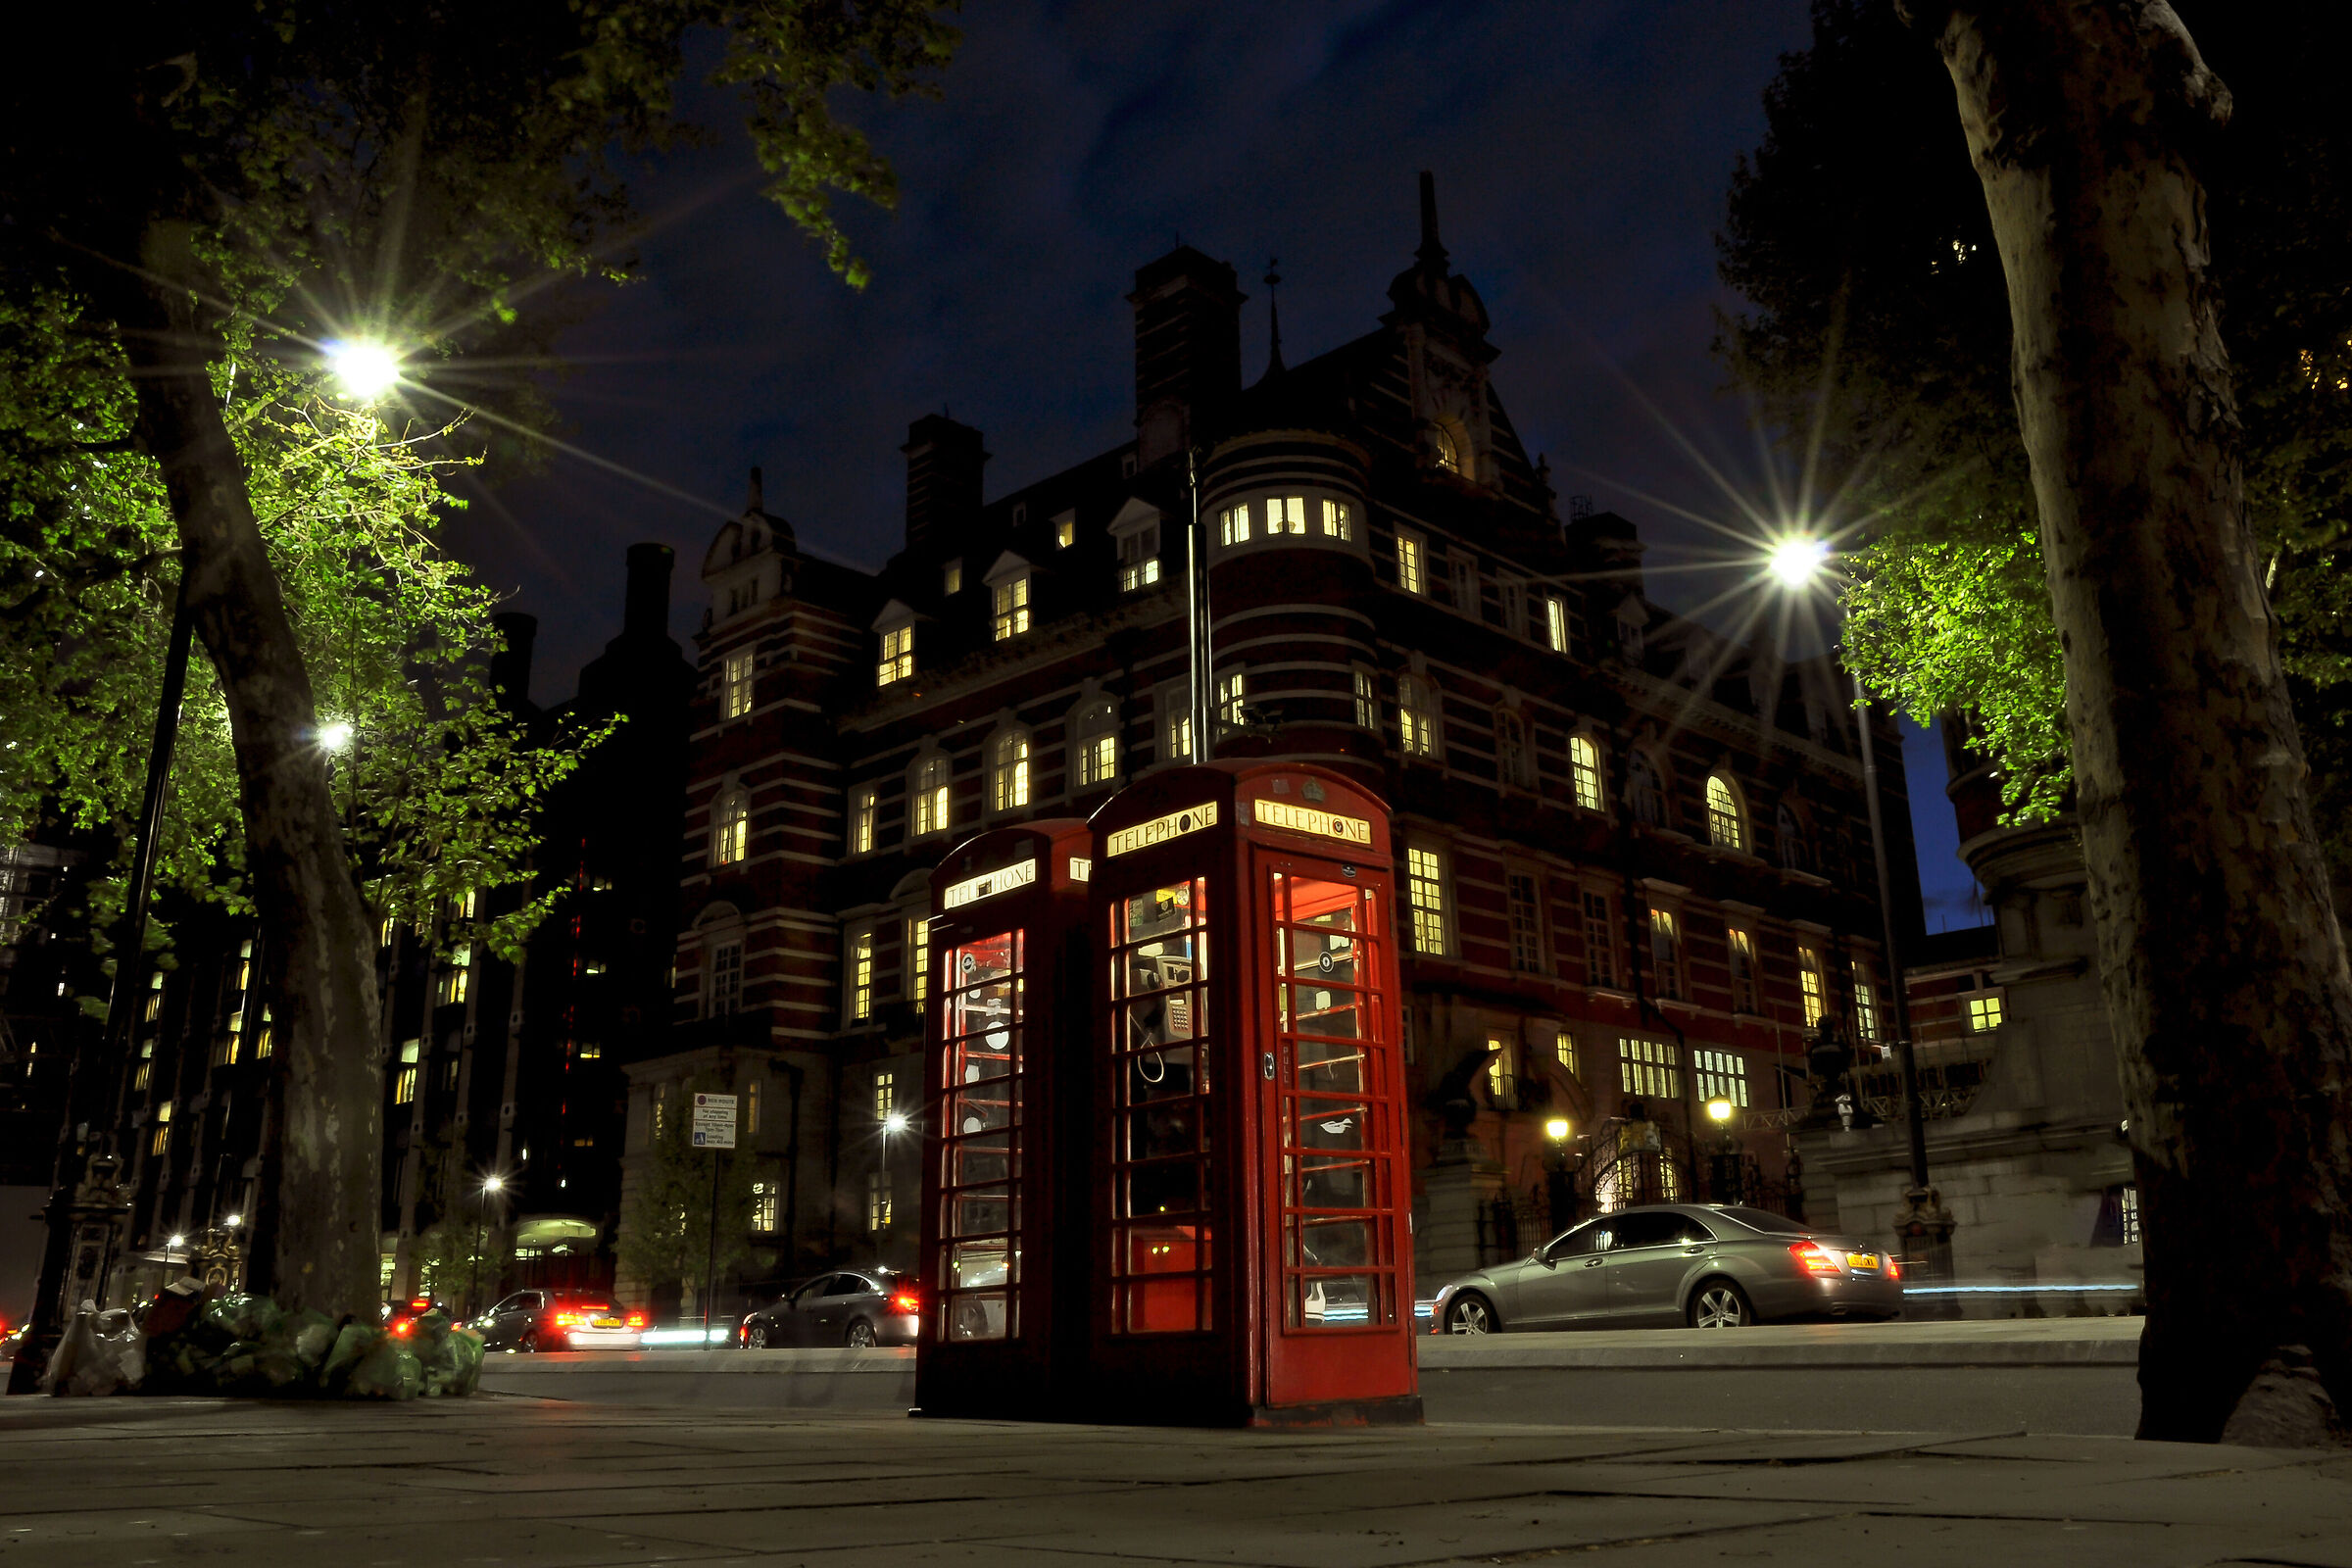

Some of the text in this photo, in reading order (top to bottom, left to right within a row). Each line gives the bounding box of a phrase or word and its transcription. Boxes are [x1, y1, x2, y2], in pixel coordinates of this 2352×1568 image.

[1112, 805, 1214, 854] TELEPHONE
[1258, 802, 1367, 841] TELEPHONE
[949, 862, 1033, 906] TELHONE
